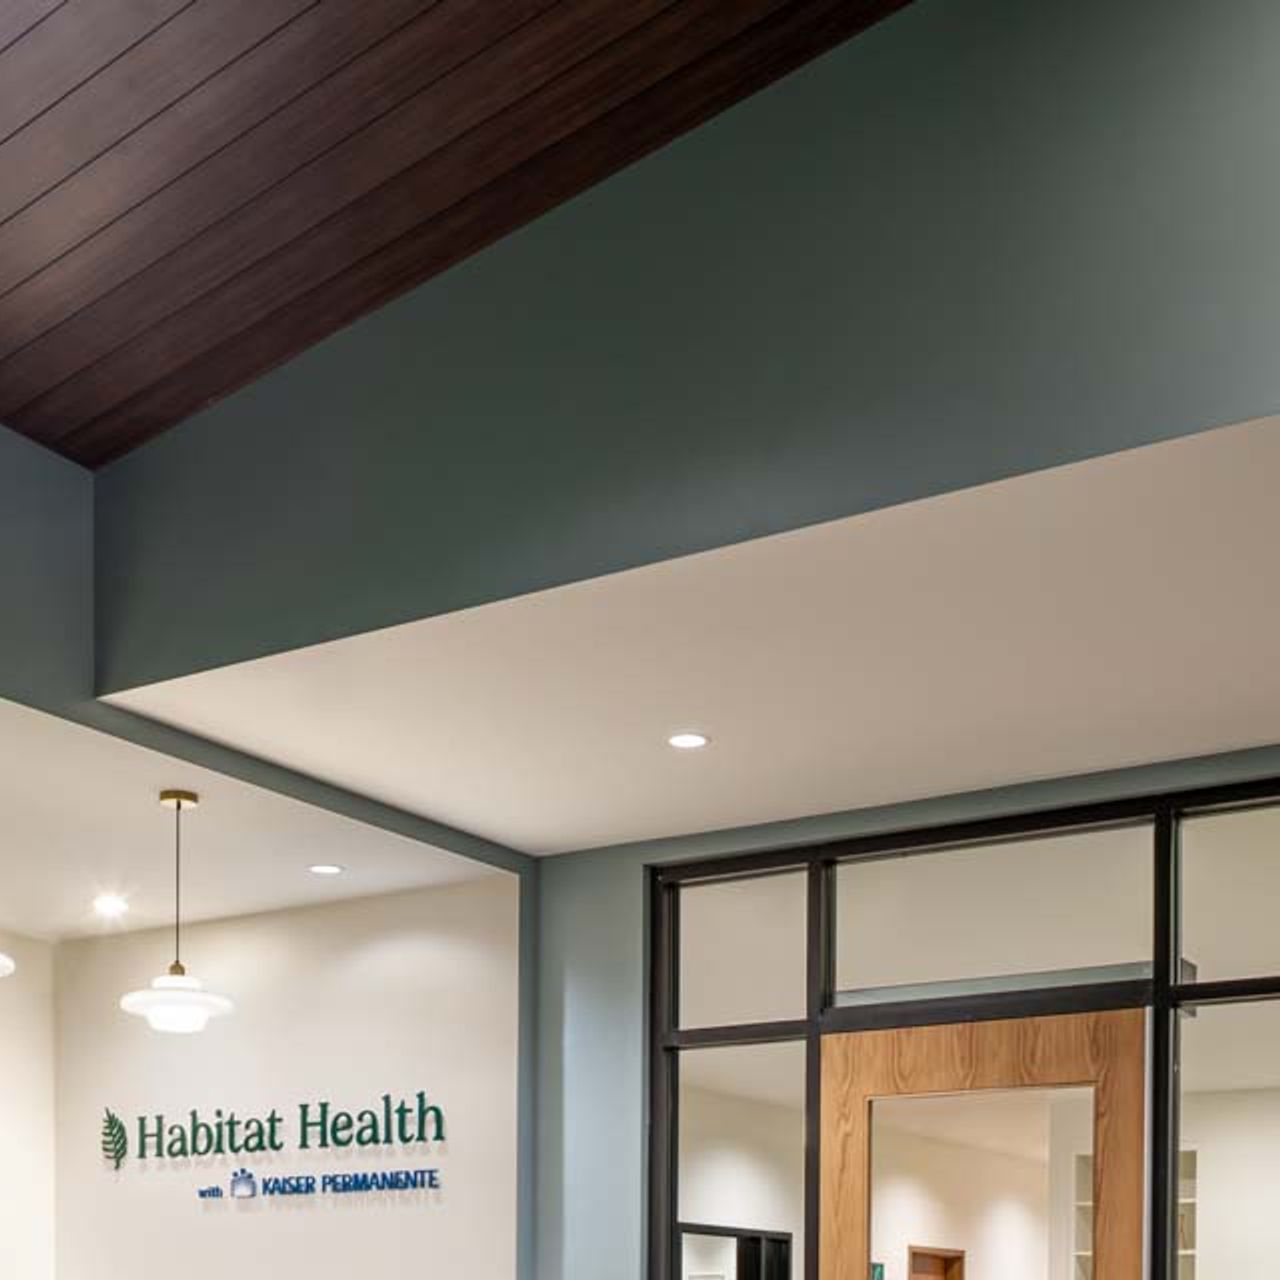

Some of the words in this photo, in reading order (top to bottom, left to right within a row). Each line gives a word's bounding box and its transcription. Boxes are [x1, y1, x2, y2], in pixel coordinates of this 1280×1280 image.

[136, 1108, 284, 1160] Habitat
[298, 1090, 446, 1149] Health
[198, 1184, 223, 1199] with
[261, 1175, 317, 1196] KAISER
[321, 1168, 441, 1194] PERMANENTE
